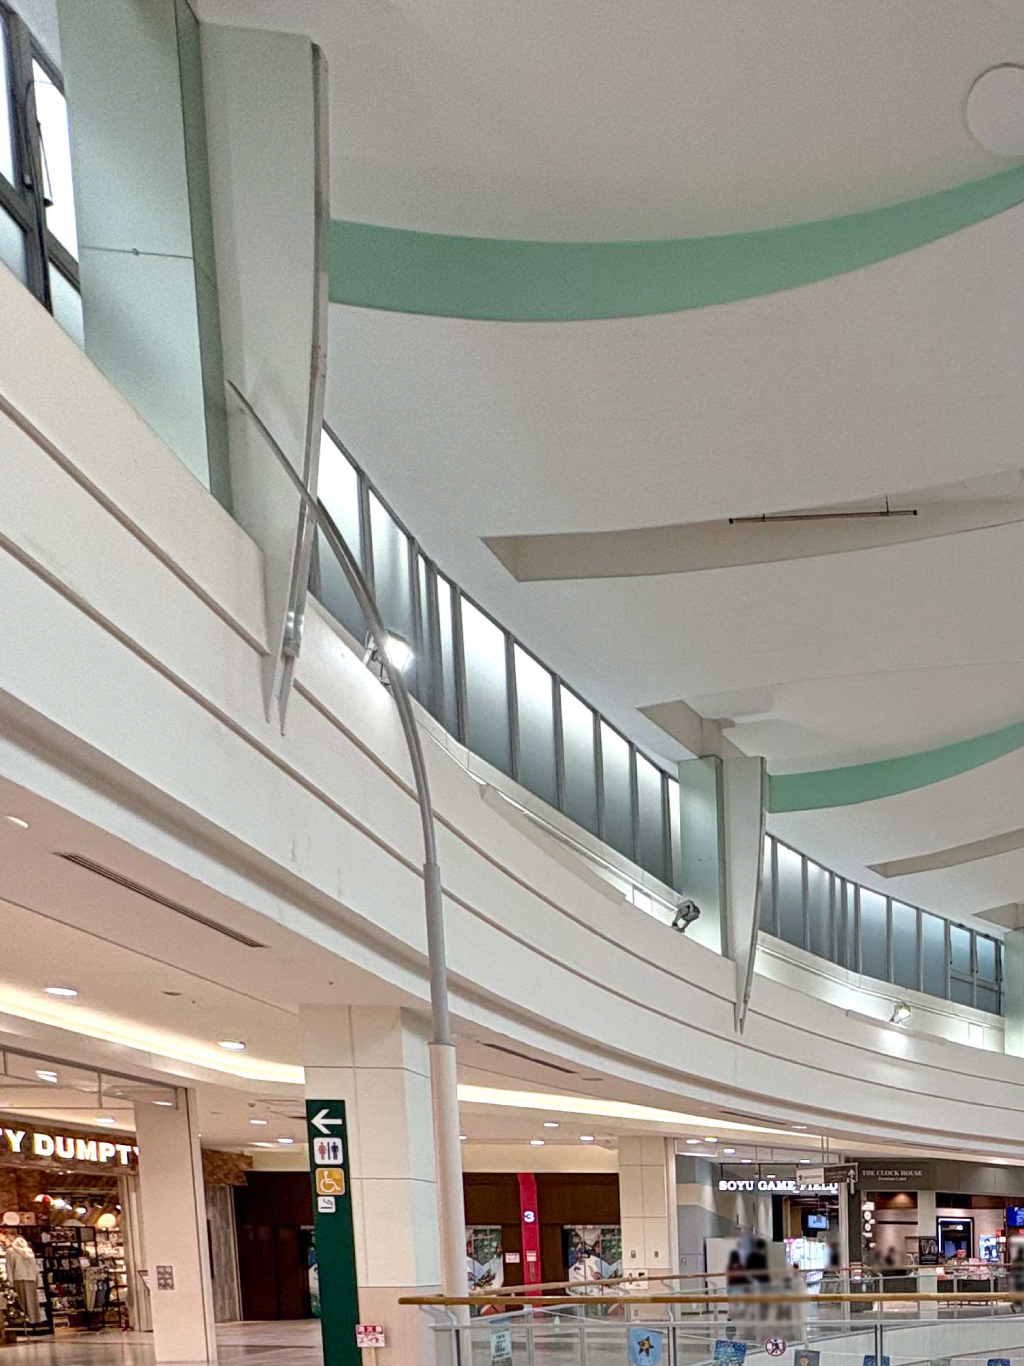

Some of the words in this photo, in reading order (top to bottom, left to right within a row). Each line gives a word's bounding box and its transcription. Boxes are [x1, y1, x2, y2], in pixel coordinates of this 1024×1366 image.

[0, 1128, 26, 1153] Y
[33, 1133, 139, 1165] DUMPT
[719, 1181, 754, 1191] SOYU
[758, 1181, 796, 1191] GAME
[524, 1211, 535, 1223] 3
